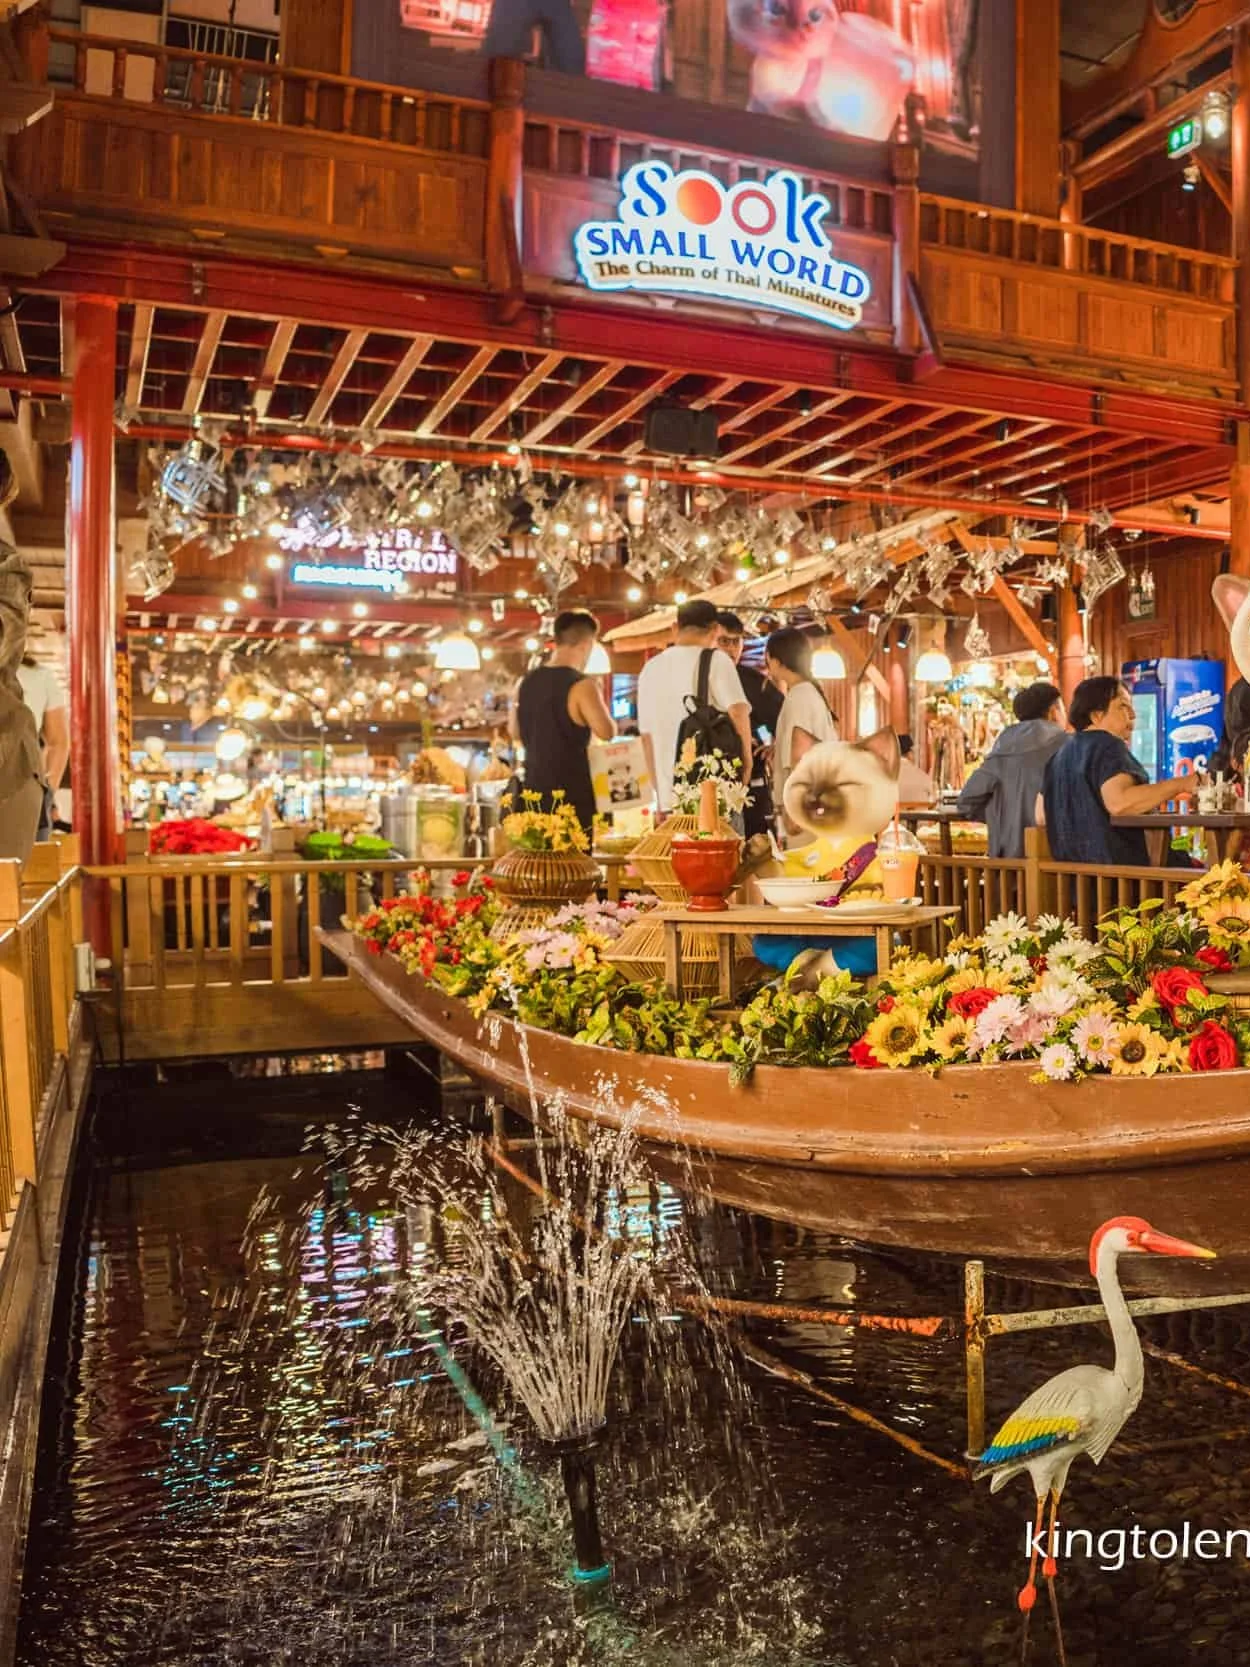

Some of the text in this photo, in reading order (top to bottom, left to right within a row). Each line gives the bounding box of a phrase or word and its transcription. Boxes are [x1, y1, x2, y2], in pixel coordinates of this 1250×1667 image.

[586, 228, 864, 298] SMALL WORLD
[595, 260, 857, 317] The Charm of Thai Miniatures
